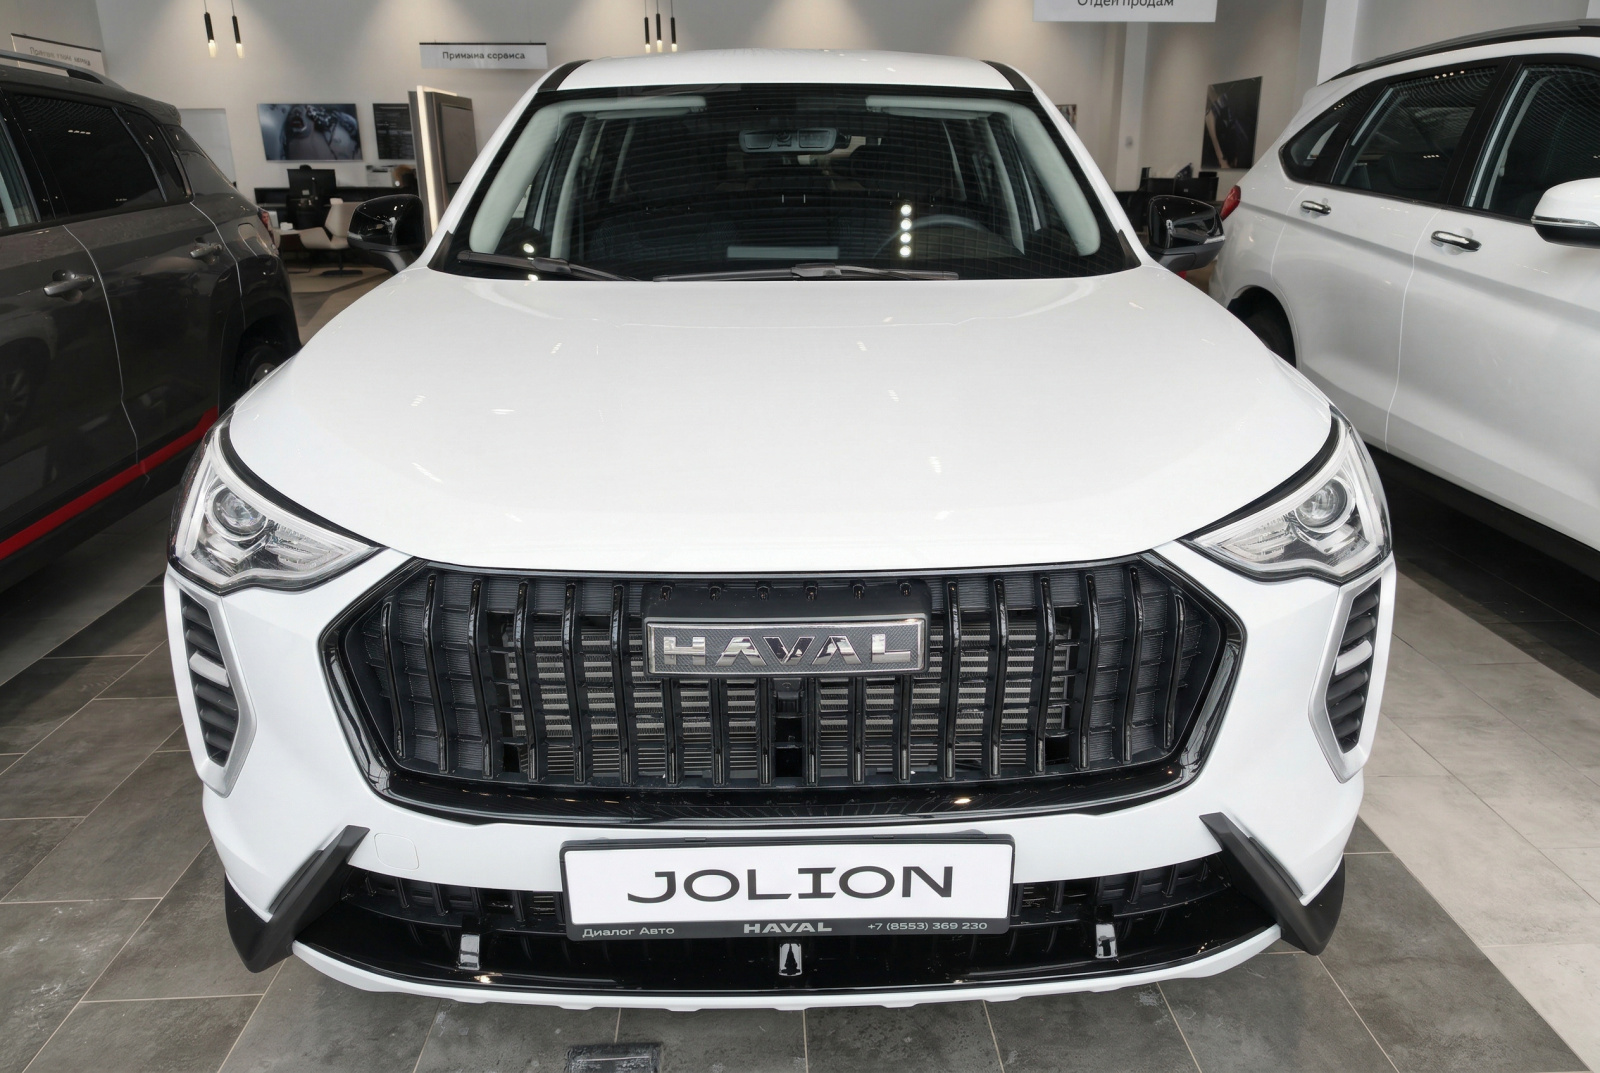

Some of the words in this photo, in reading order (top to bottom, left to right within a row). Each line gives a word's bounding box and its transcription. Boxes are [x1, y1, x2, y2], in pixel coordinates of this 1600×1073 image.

[663, 633, 912, 667] HAVAL
[627, 865, 954, 904] JOLION
[582, 928, 635, 938] Диалог
[639, 926, 675, 935] Авто
[743, 921, 833, 935] HAVAL
[867, 922, 883, 931] +7
[886, 922, 929, 931] (8553)
[932, 922, 959, 930] 369
[961, 922, 988, 930] 230
